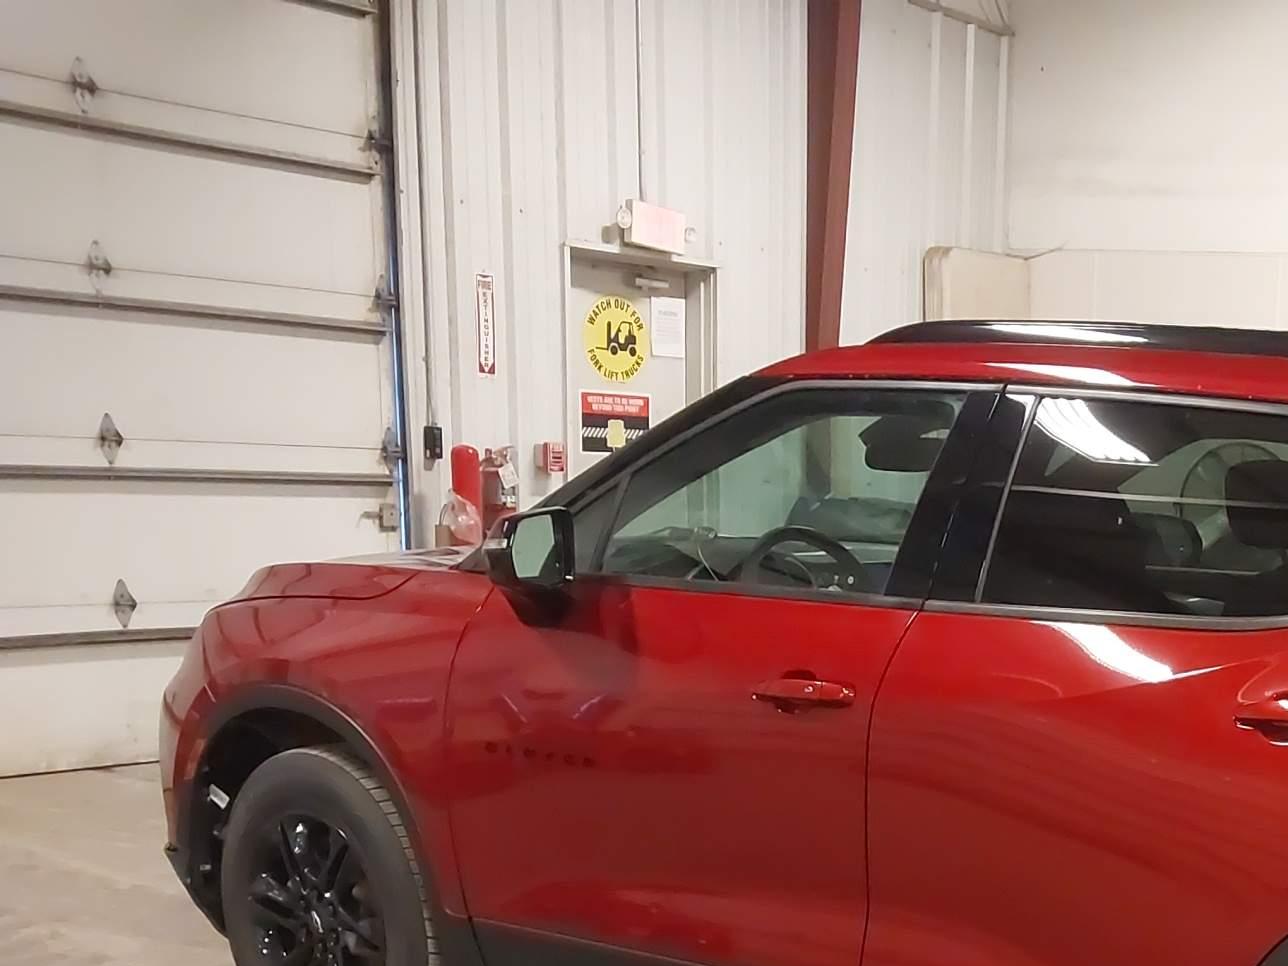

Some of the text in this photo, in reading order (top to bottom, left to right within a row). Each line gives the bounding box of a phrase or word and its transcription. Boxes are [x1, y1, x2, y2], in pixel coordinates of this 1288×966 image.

[482, 291, 490, 368] EXTINGUISHER
[587, 299, 612, 325] WATCH
[614, 299, 631, 313] OUT
[630, 310, 644, 331] FOR
[587, 348, 644, 381] FORK LIFT TRUCKS
